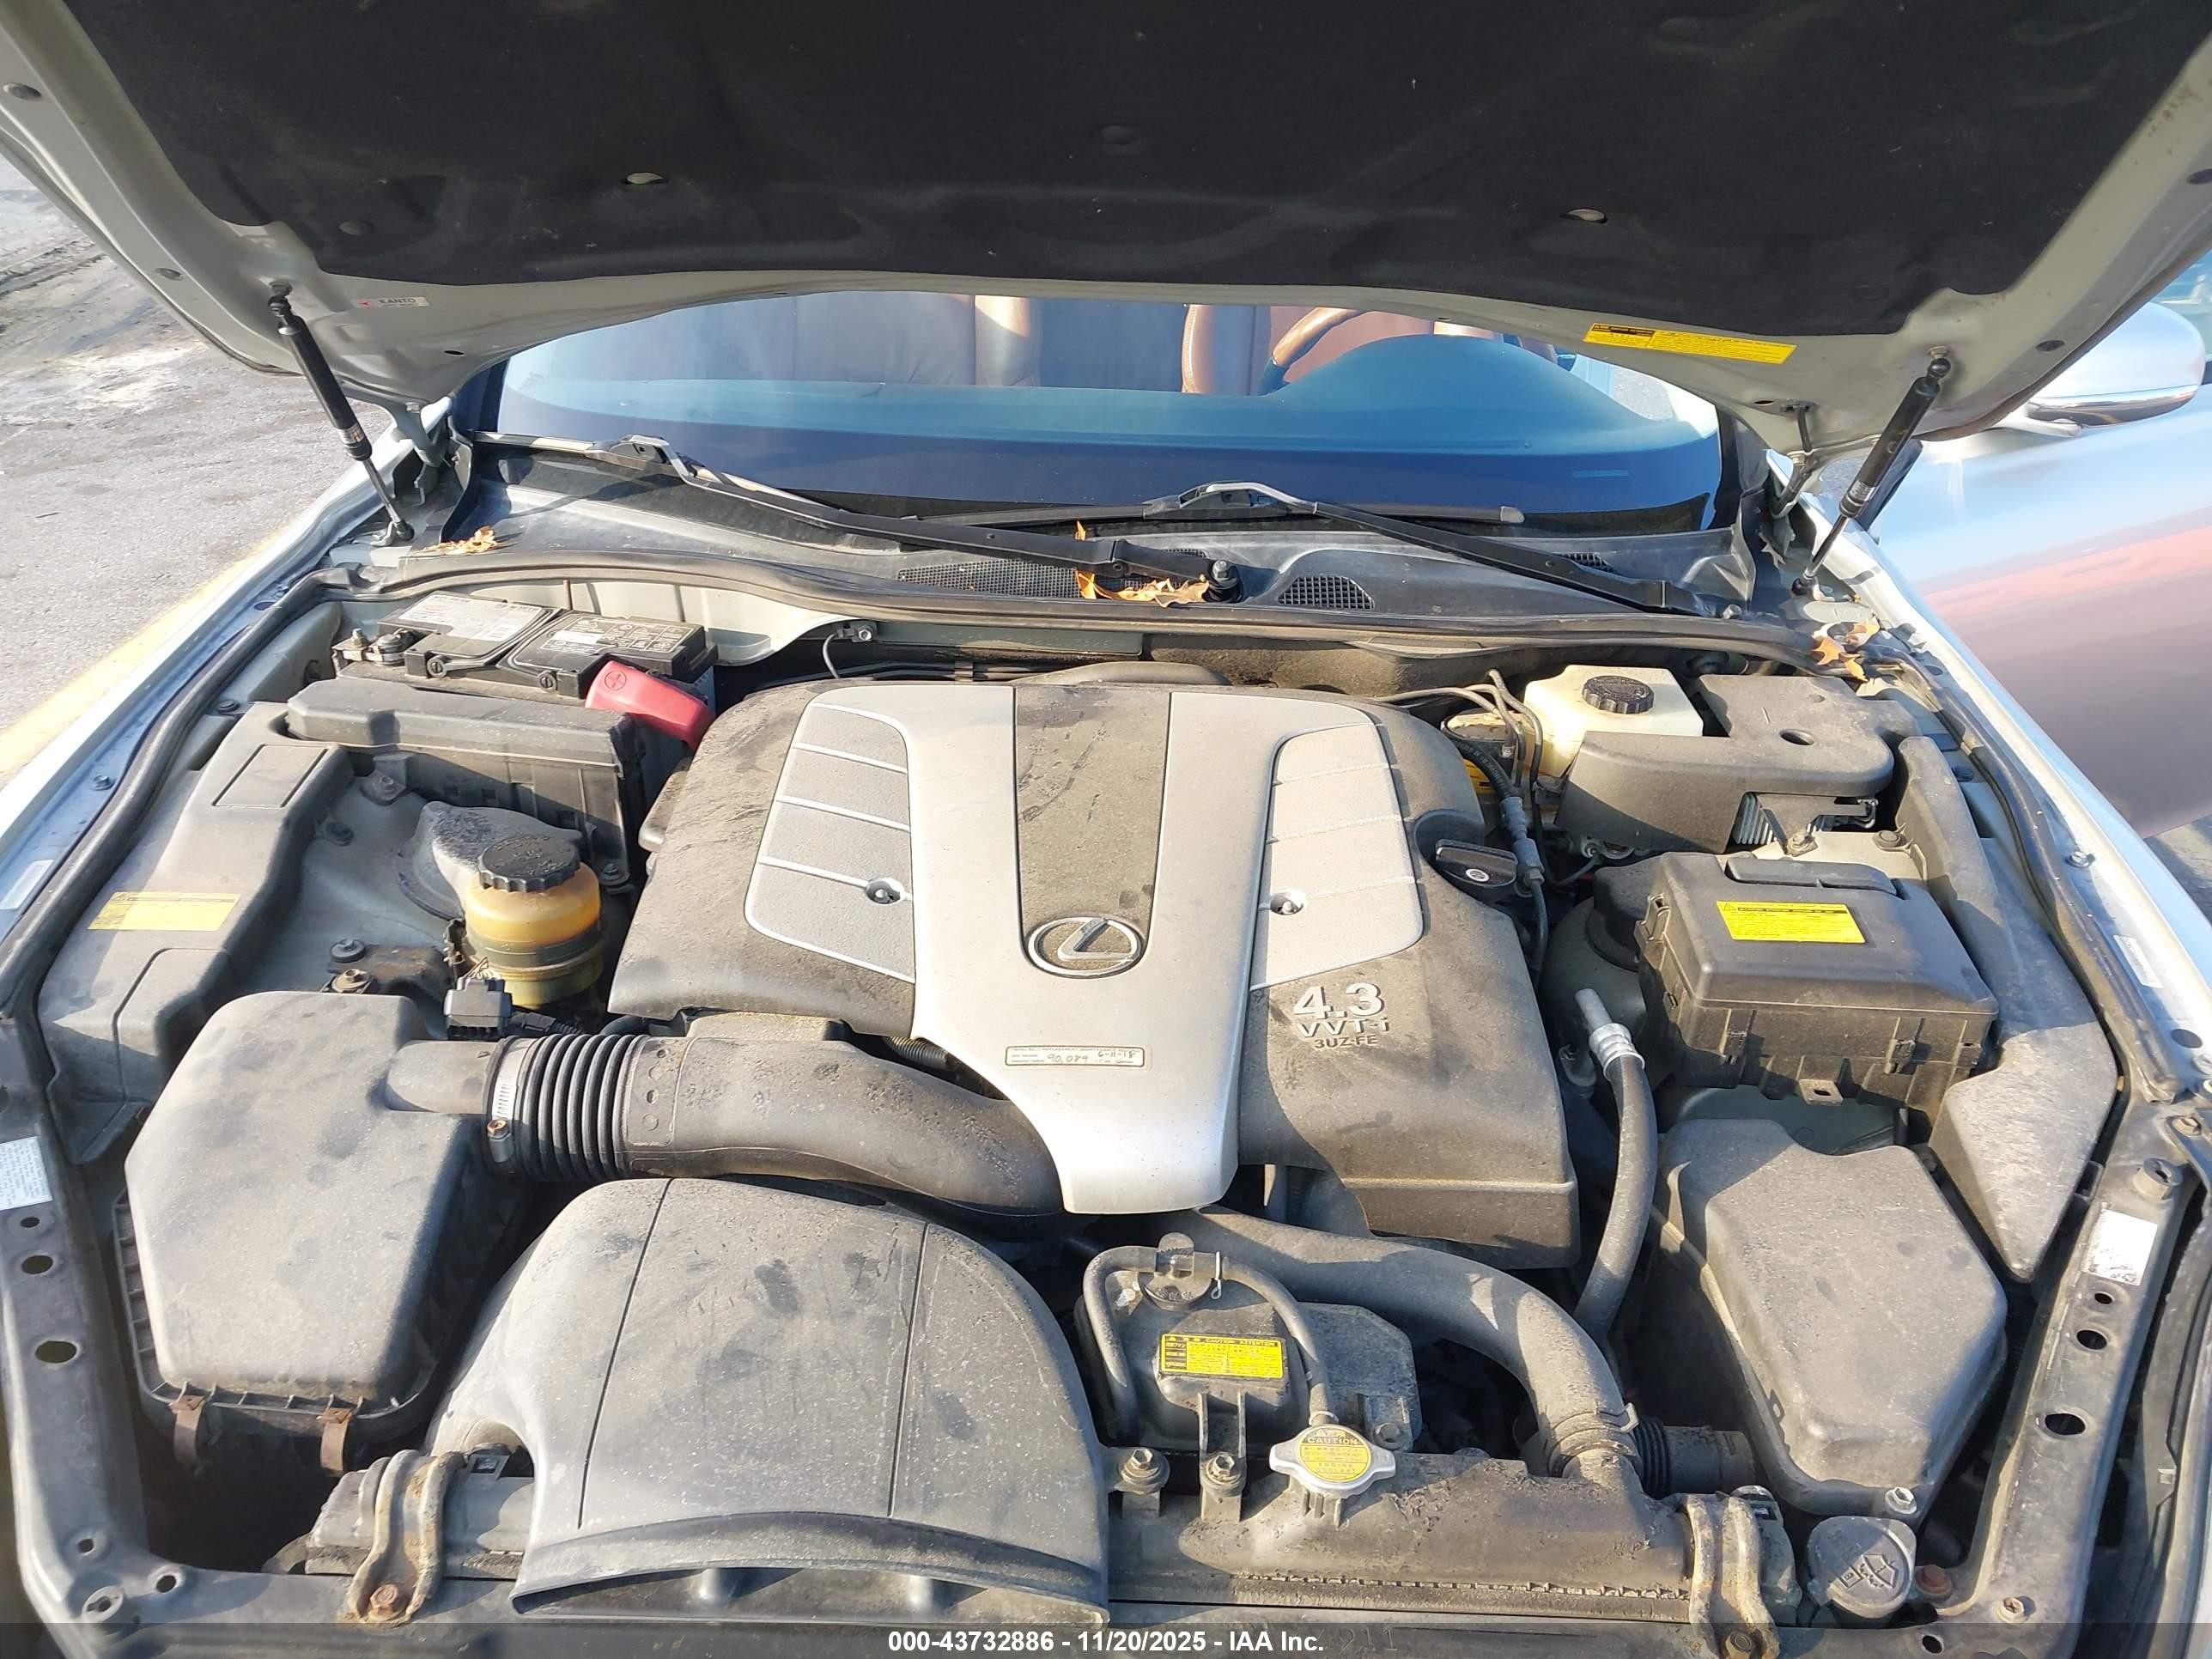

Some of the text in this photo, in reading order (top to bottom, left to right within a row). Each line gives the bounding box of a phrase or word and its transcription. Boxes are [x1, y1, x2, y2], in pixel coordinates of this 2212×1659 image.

[1293, 982, 1385, 1020] 4.3
[1297, 1017, 1389, 1038] VVT-i
[1314, 1035, 1378, 1049] 3UZ-FE
[1307, 1437, 1358, 1445] CAUTION
